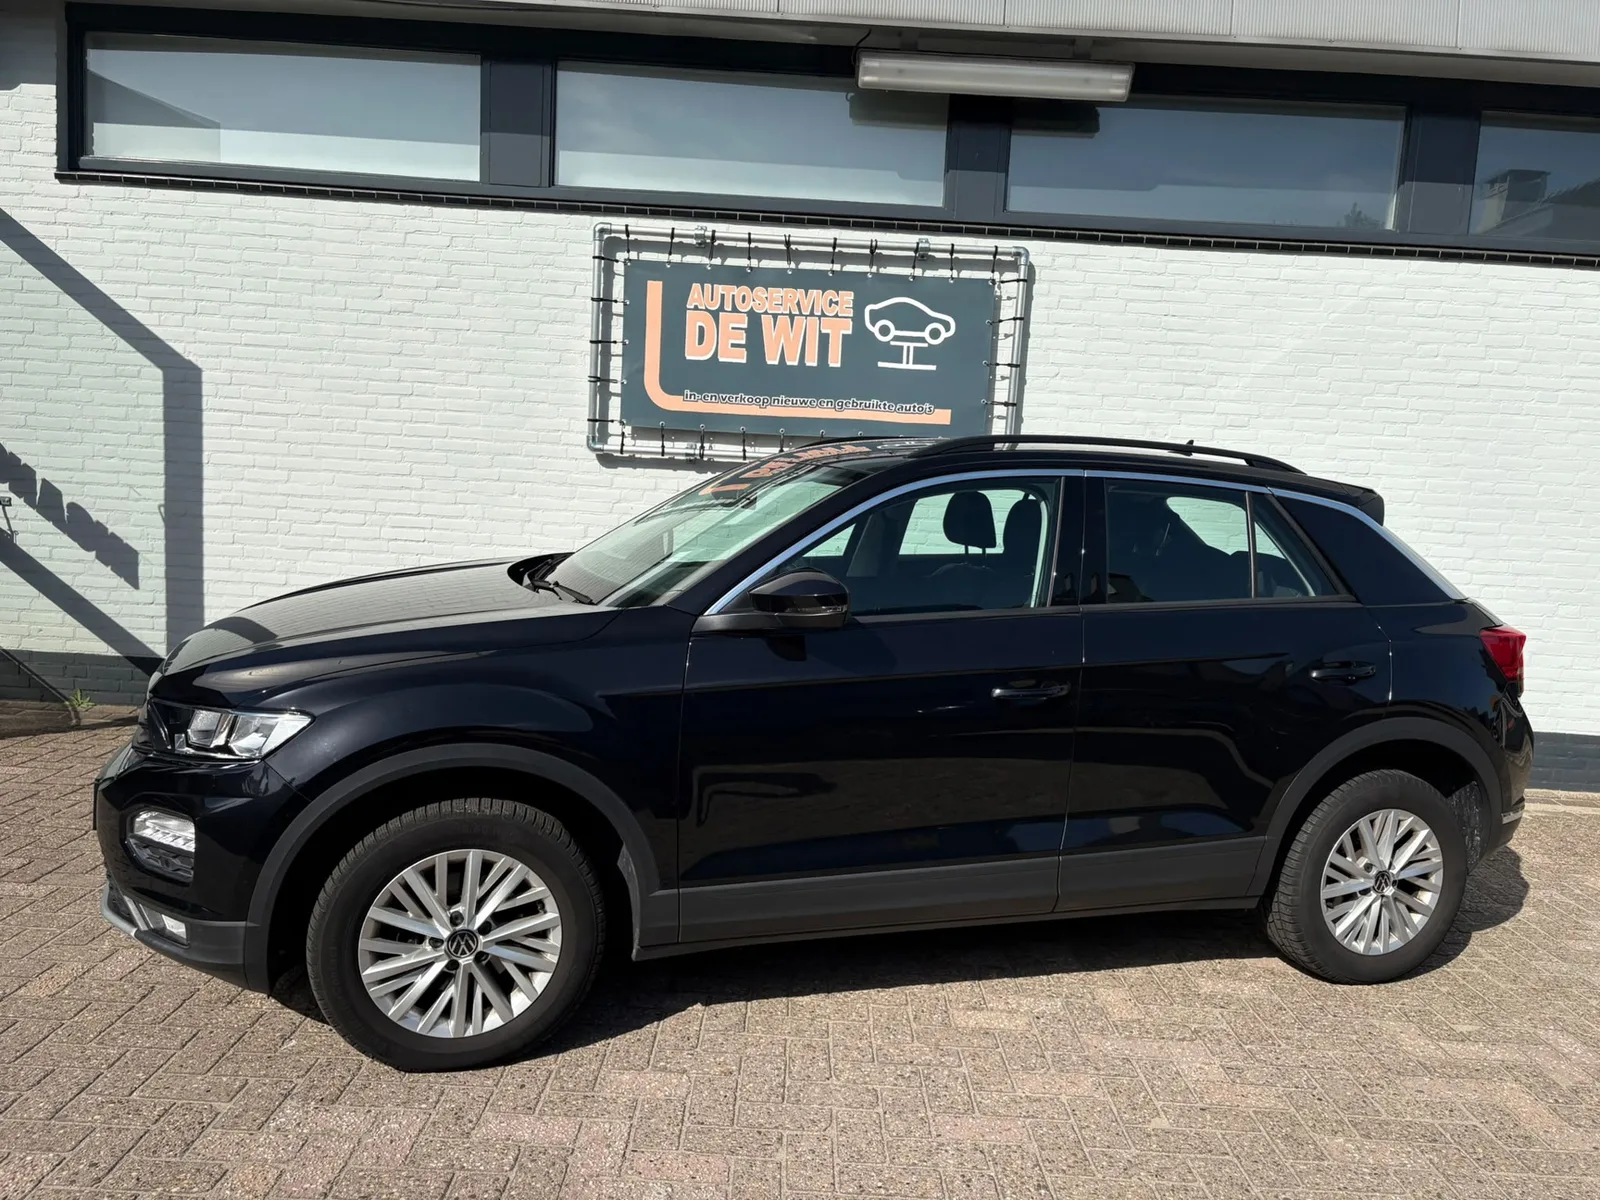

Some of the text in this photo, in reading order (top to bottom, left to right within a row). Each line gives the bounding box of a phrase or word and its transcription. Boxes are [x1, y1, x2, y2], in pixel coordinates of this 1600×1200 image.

[686, 283, 854, 317] AUTOSERVICE
[685, 310, 853, 367] DE WIT
[701, 392, 719, 402] en
[719, 393, 769, 408] verkoop
[771, 395, 816, 408] nieuwe
[817, 398, 834, 409] en
[835, 398, 895, 412] gebruikte
[895, 403, 934, 414] auto's
